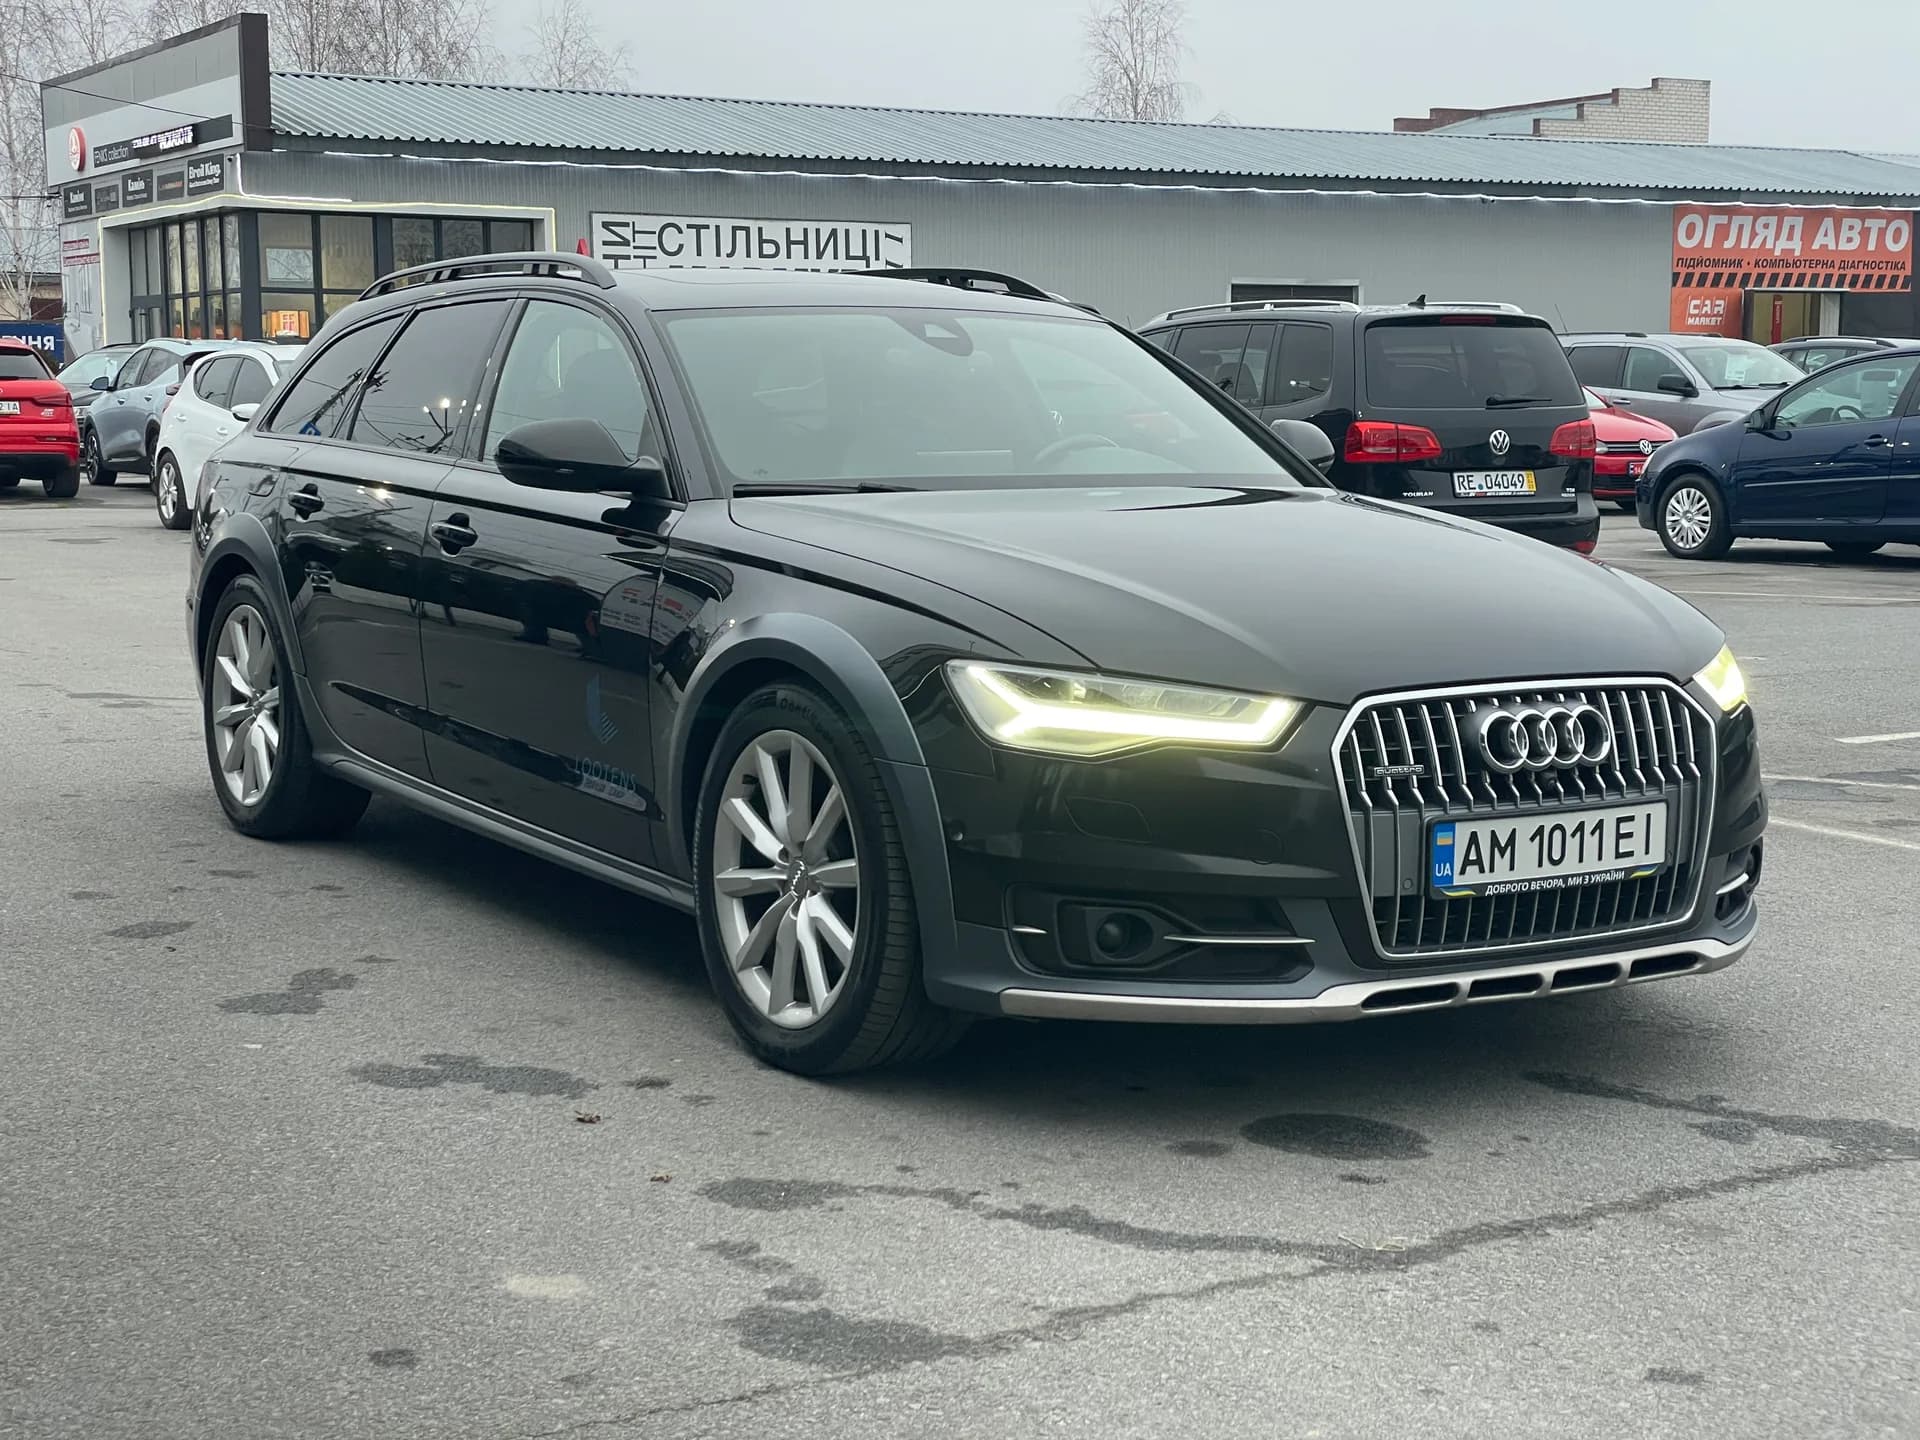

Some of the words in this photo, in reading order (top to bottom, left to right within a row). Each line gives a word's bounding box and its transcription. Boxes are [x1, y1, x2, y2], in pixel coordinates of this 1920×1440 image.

[1677, 213, 1804, 256] ОГЛЯД
[1811, 217, 1910, 253] АВТО
[657, 222, 881, 269] СТІЛЬНИЦІ
[1676, 256, 1744, 270] ПІДЙОМНИК
[1838, 259, 1906, 272] ДІАГНОСТІКА
[1689, 299, 1726, 315] CAR
[1687, 316, 1724, 326] MARKET
[1457, 474, 1477, 491] RE
[1484, 473, 1525, 490] 04049
[1376, 766, 1423, 776] quattro
[1459, 827, 1517, 876] AM
[1529, 818, 1605, 869] 1011
[1614, 813, 1652, 860] EI
[1435, 863, 1452, 877] UA
[1485, 882, 1529, 896] ДОБРОГО
[1530, 878, 1566, 890] ВЕЧОРА,
[1567, 876, 1583, 887] МИ
[1590, 870, 1625, 884] УКРАЇНИ
